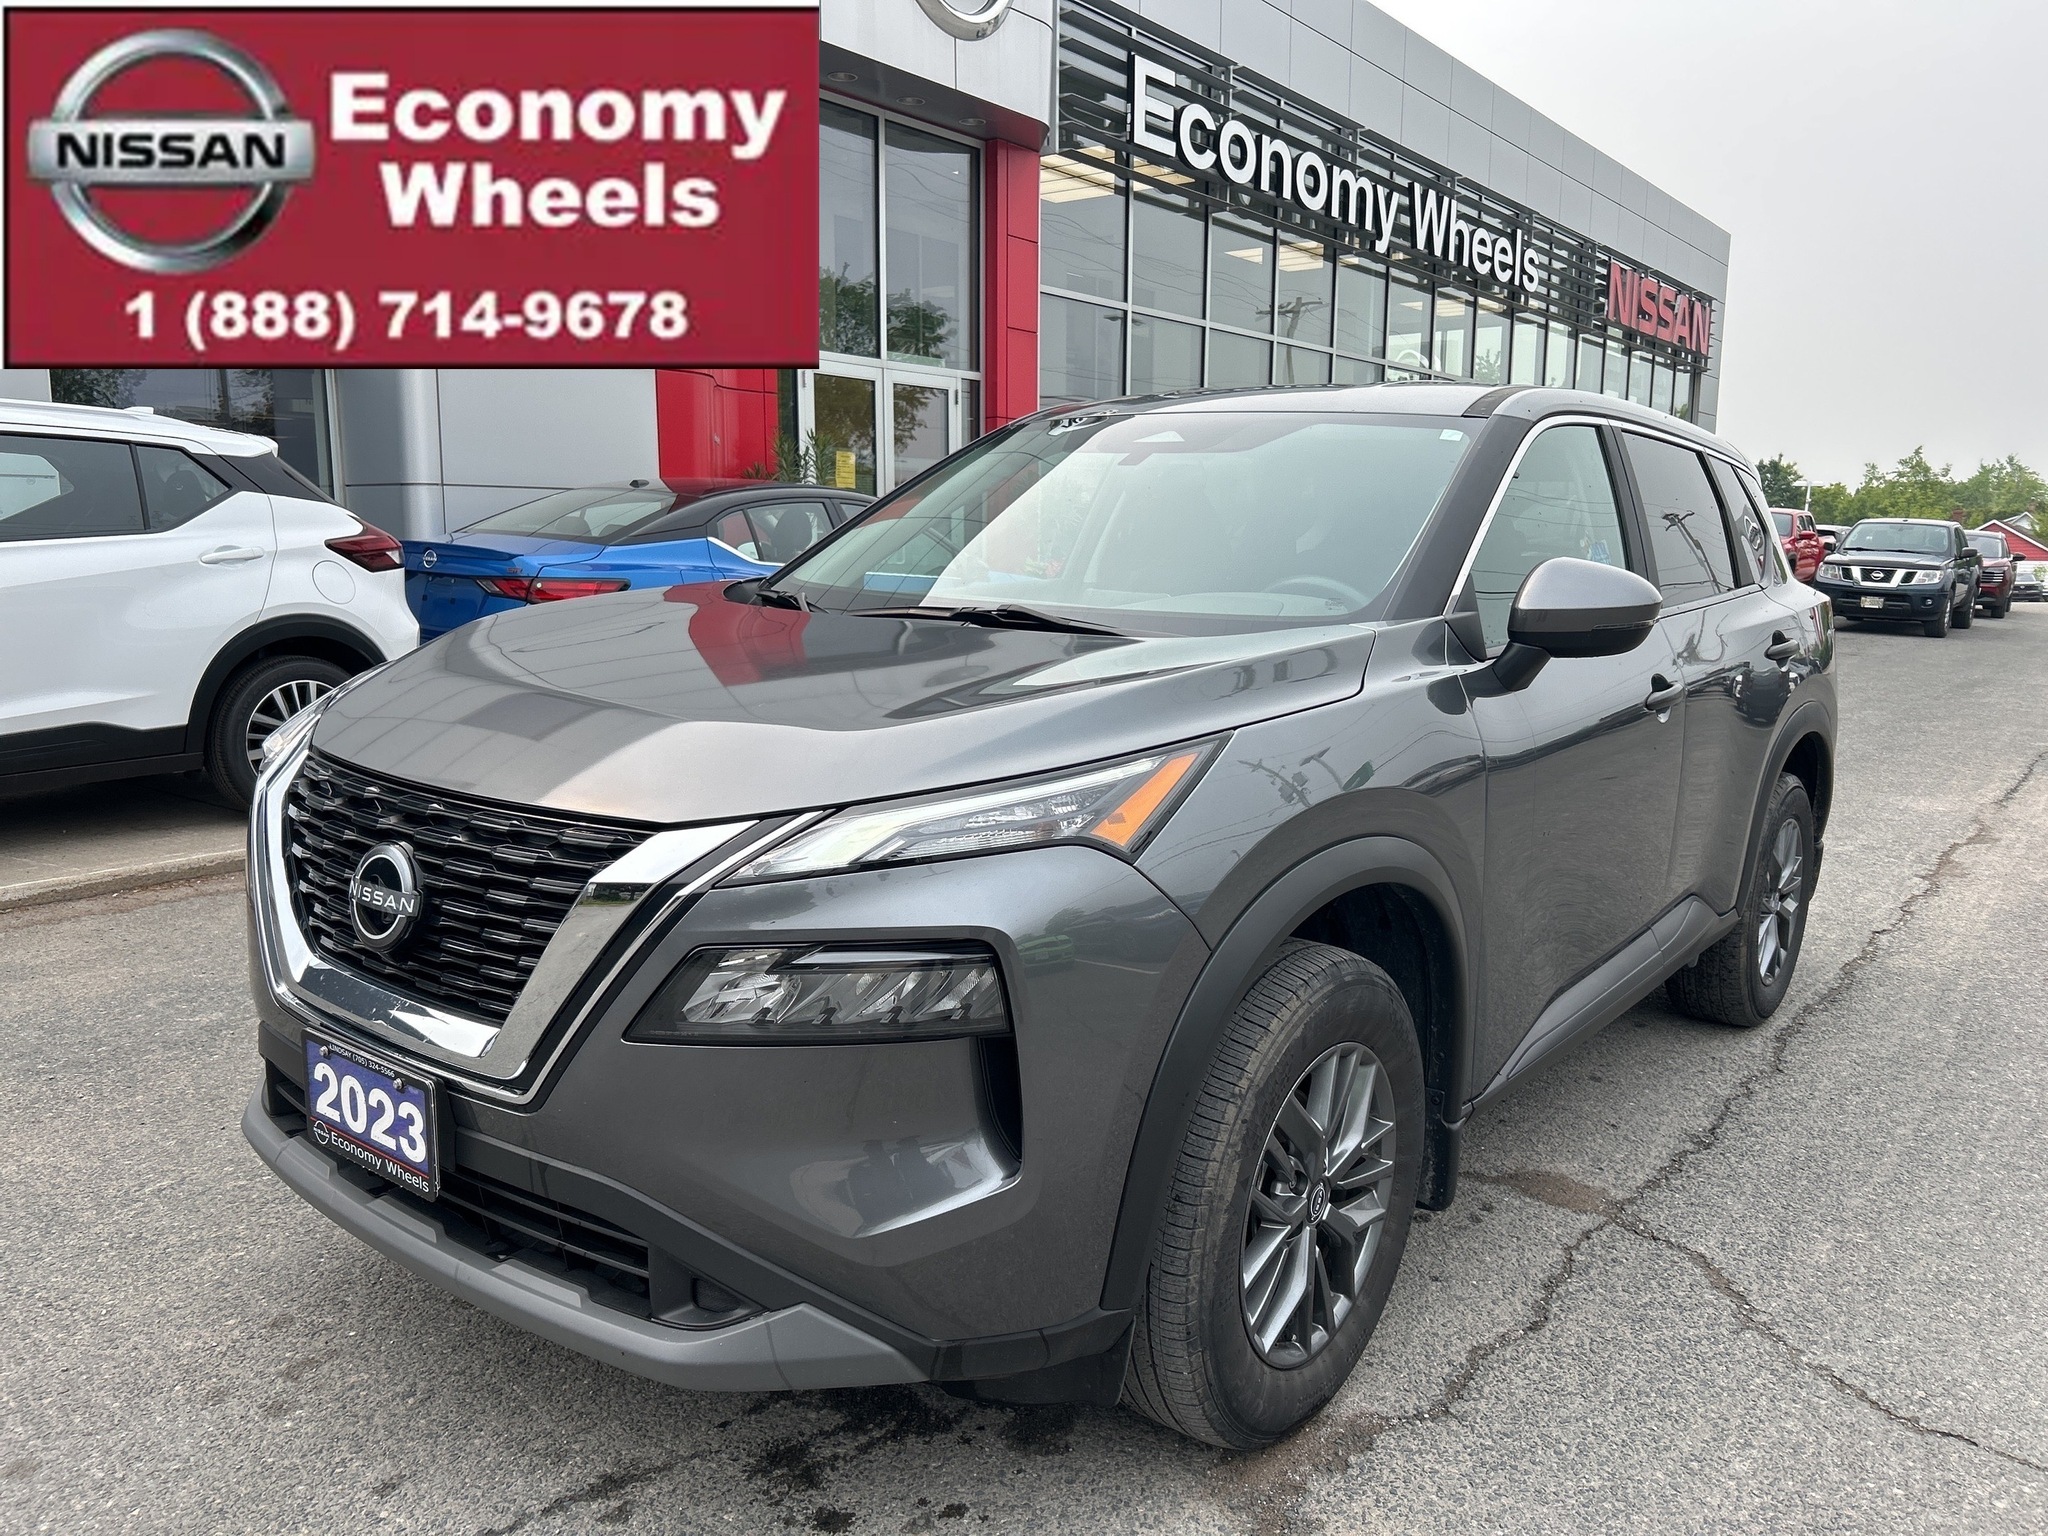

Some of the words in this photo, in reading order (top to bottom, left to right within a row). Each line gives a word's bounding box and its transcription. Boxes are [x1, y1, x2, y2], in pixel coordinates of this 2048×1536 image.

[1131, 53, 1398, 254] Economy
[1411, 181, 1540, 293] Wheels
[1608, 262, 1710, 355] NISSAN
[351, 880, 414, 912] NISSAN
[330, 1043, 352, 1058] LINDSAY
[352, 1054, 368, 1067] (705)
[314, 1062, 427, 1163] 2023
[331, 1131, 382, 1170] Economy
[385, 1158, 430, 1193] Wheels
